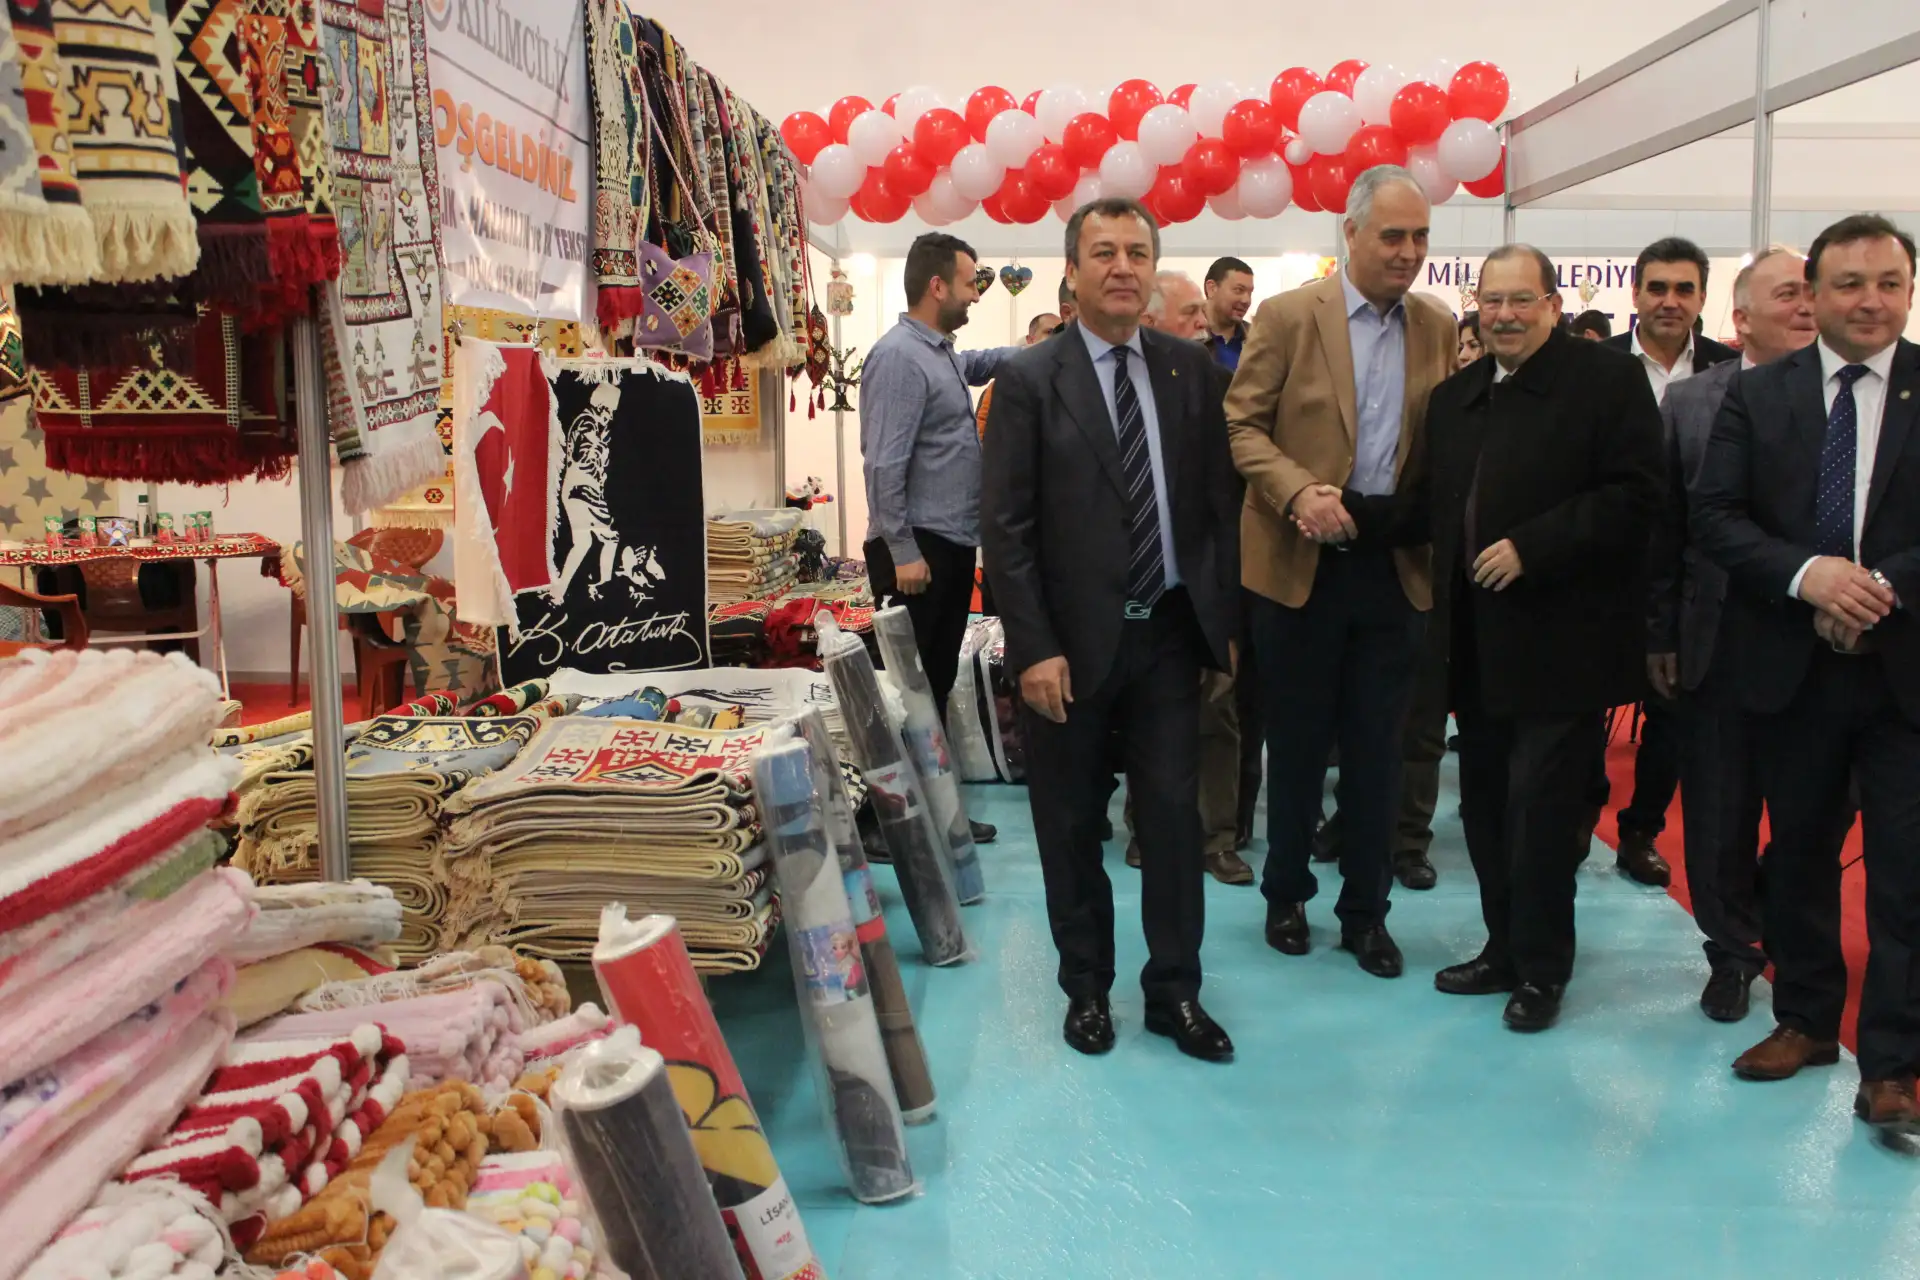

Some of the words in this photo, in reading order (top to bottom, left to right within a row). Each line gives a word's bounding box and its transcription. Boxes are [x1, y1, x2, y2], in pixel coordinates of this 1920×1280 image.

[433, 88, 576, 203] OŞGELDİNİZ
[1428, 257, 1475, 286] MİL
[1557, 259, 1636, 288] LEDİY
